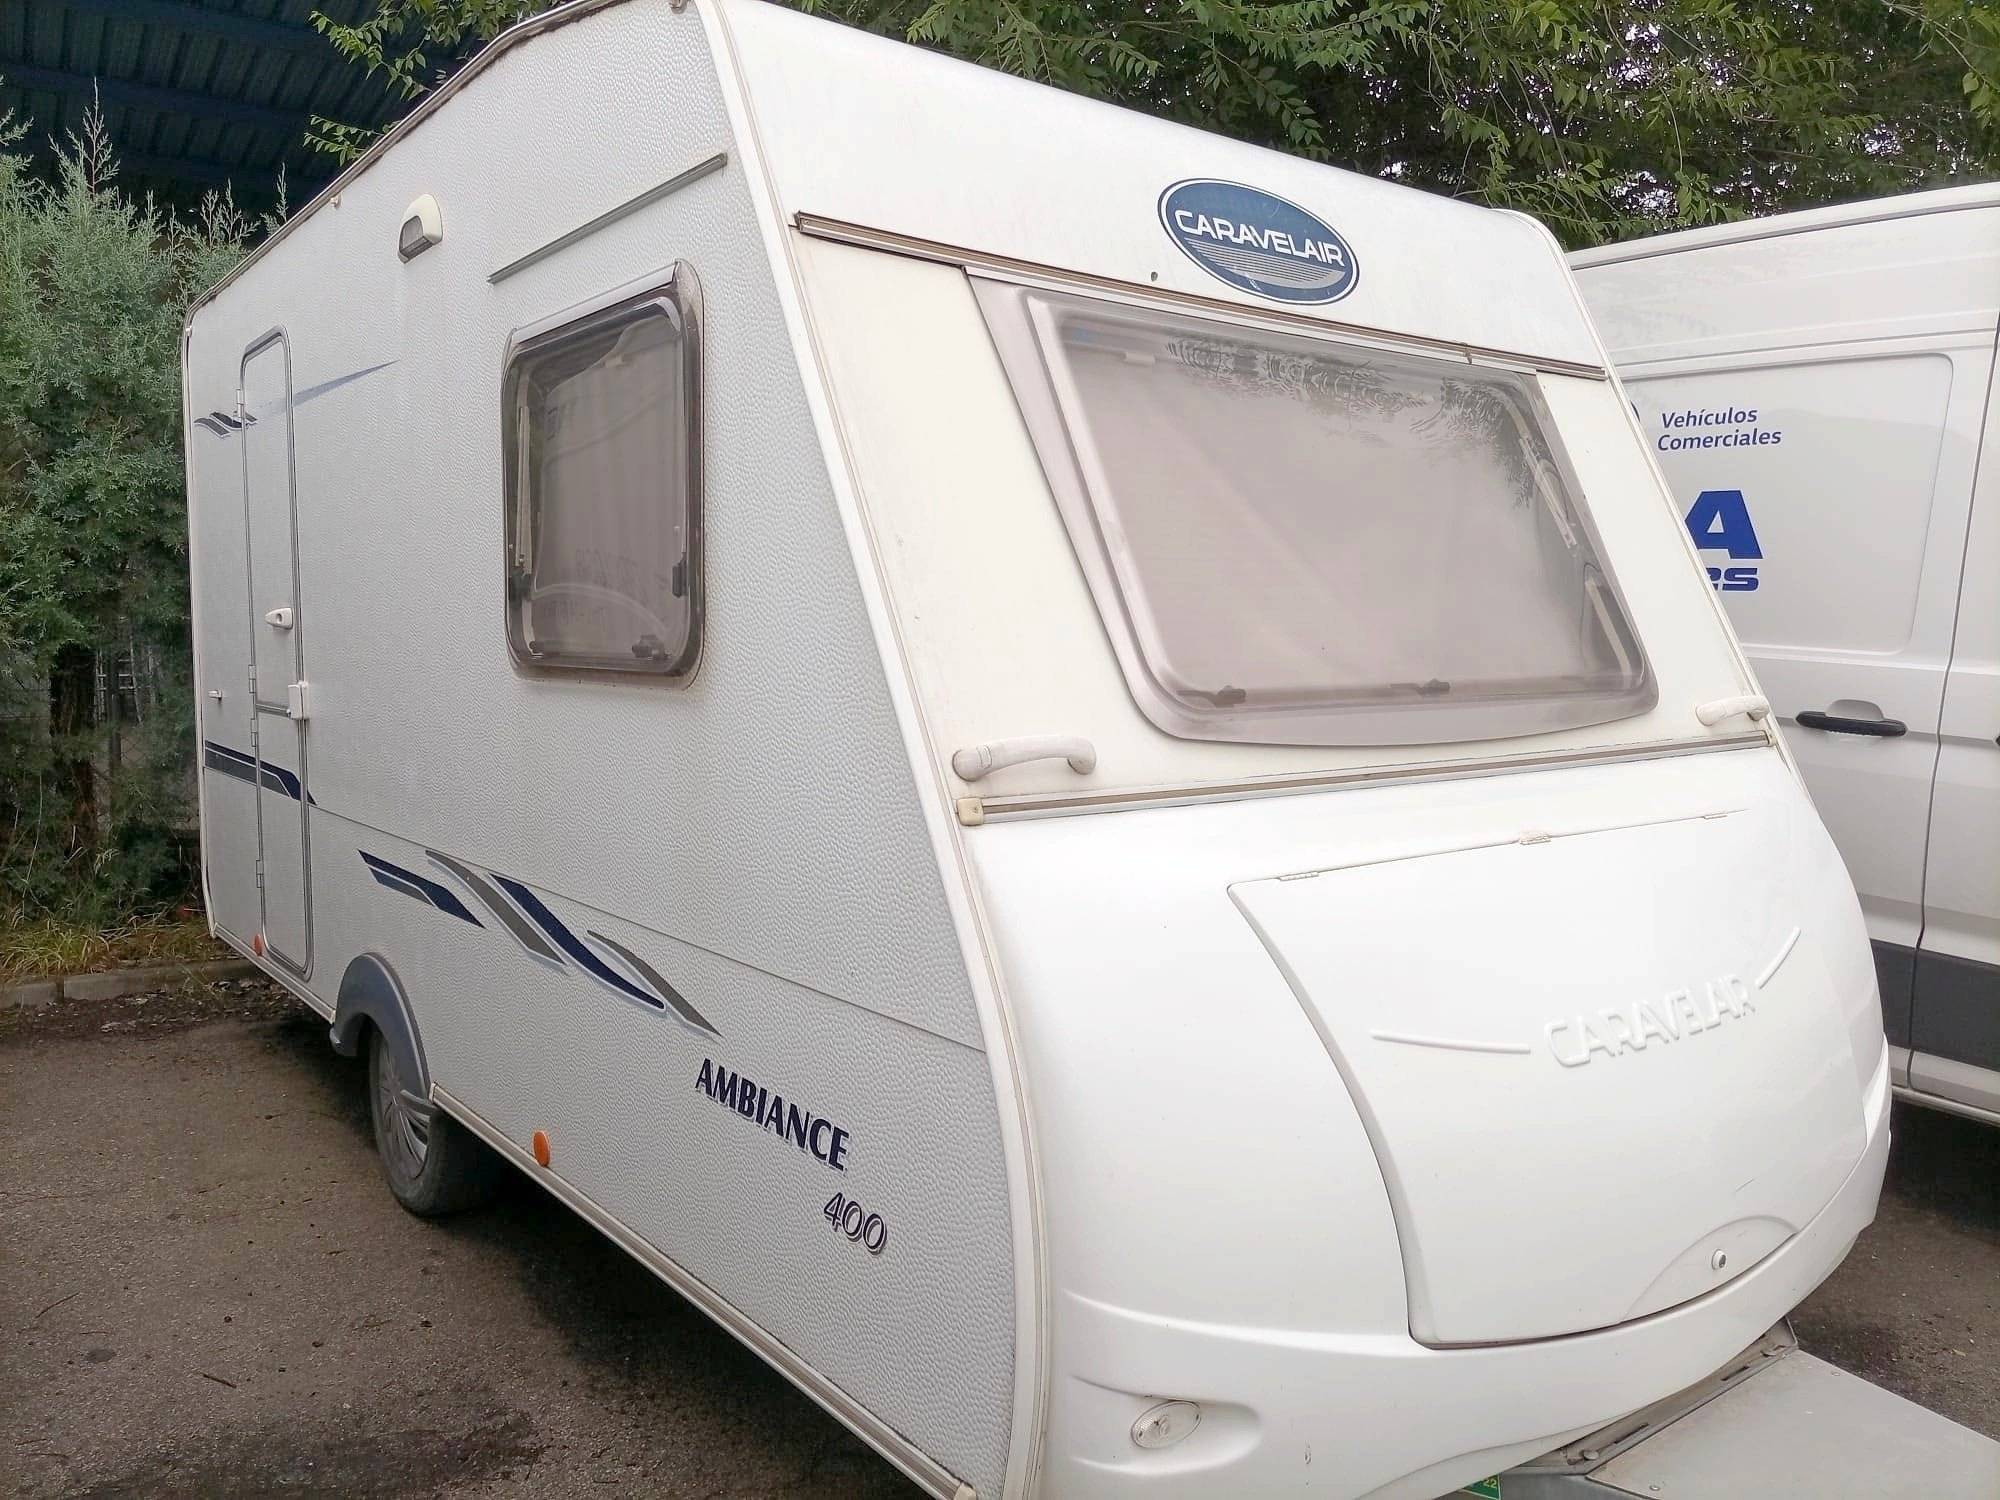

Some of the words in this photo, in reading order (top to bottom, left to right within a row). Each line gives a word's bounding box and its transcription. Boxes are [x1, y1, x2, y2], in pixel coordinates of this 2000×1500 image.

[1174, 210, 1345, 267] CARAVELAIR
[1657, 428, 1782, 451] Comerciales
[1661, 407, 1758, 429] Vehículos
[695, 1058, 850, 1172] AMBIANCE
[823, 1191, 887, 1255] 400
